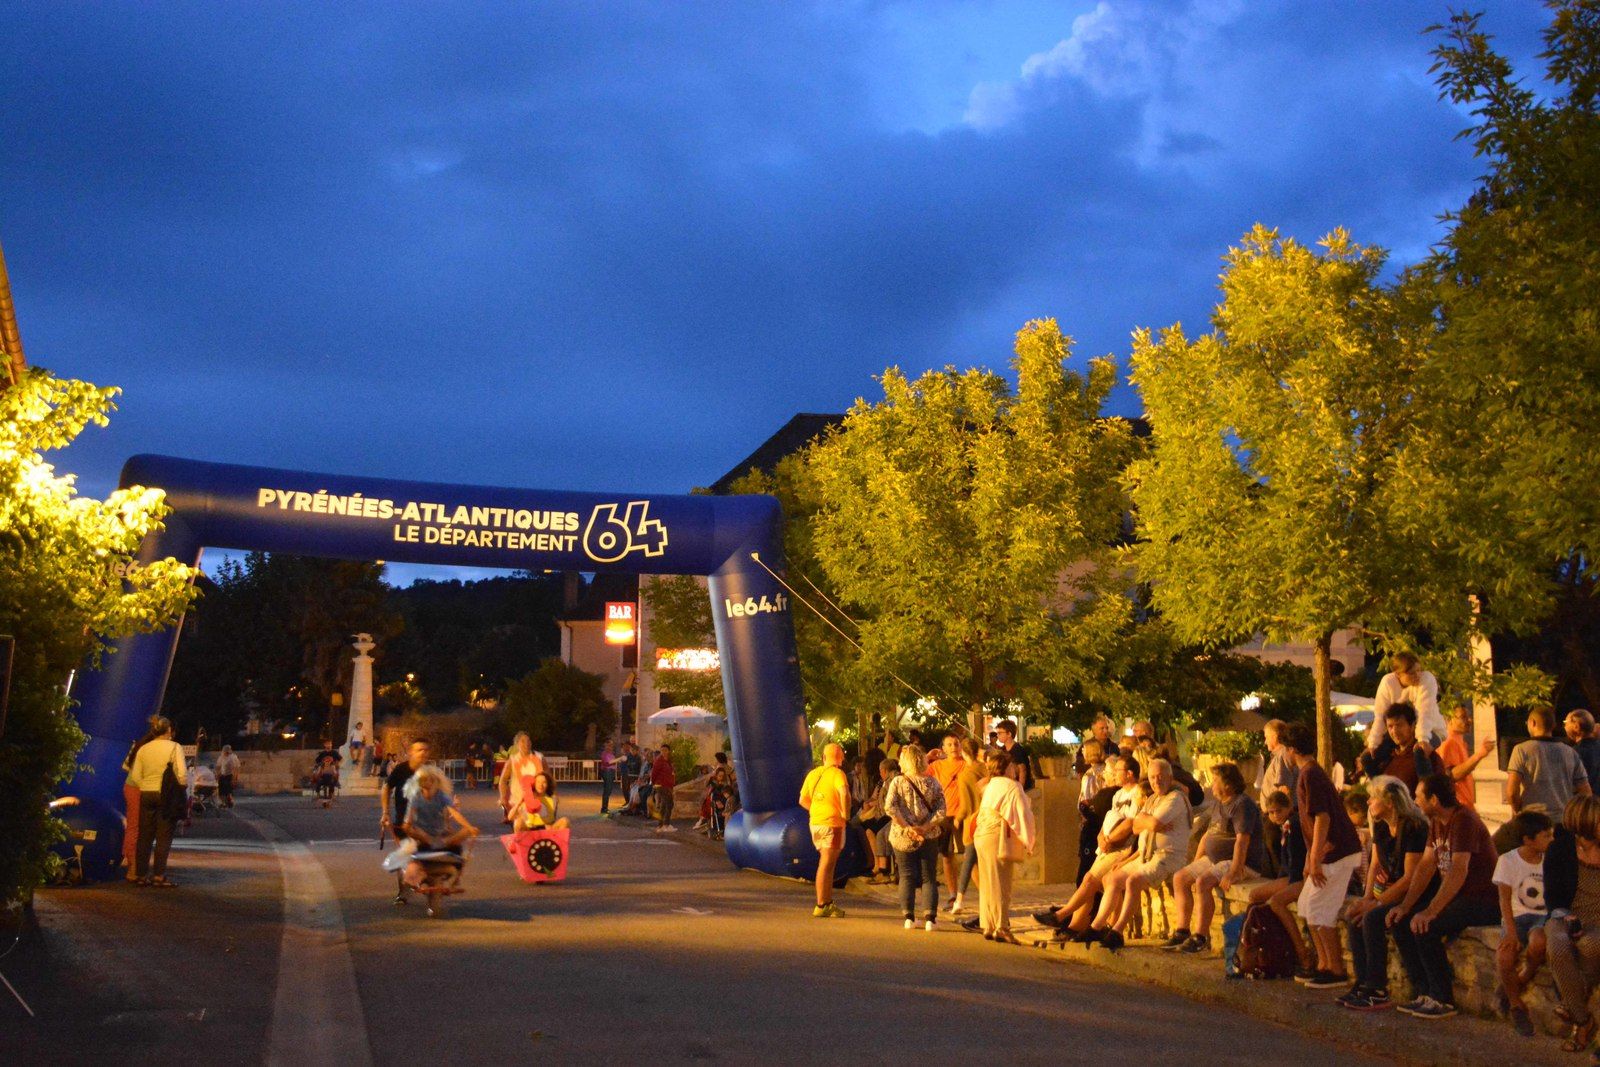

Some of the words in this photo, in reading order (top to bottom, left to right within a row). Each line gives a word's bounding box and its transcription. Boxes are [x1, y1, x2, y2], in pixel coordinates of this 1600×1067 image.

[258, 488, 579, 531] PYRÉNÉES-ATLANTIQUES
[394, 524, 418, 542] LE
[425, 522, 578, 552] DÉPARTEMENT
[583, 500, 669, 563] 64
[608, 605, 632, 619] BAR
[725, 593, 787, 618] le64.fr
